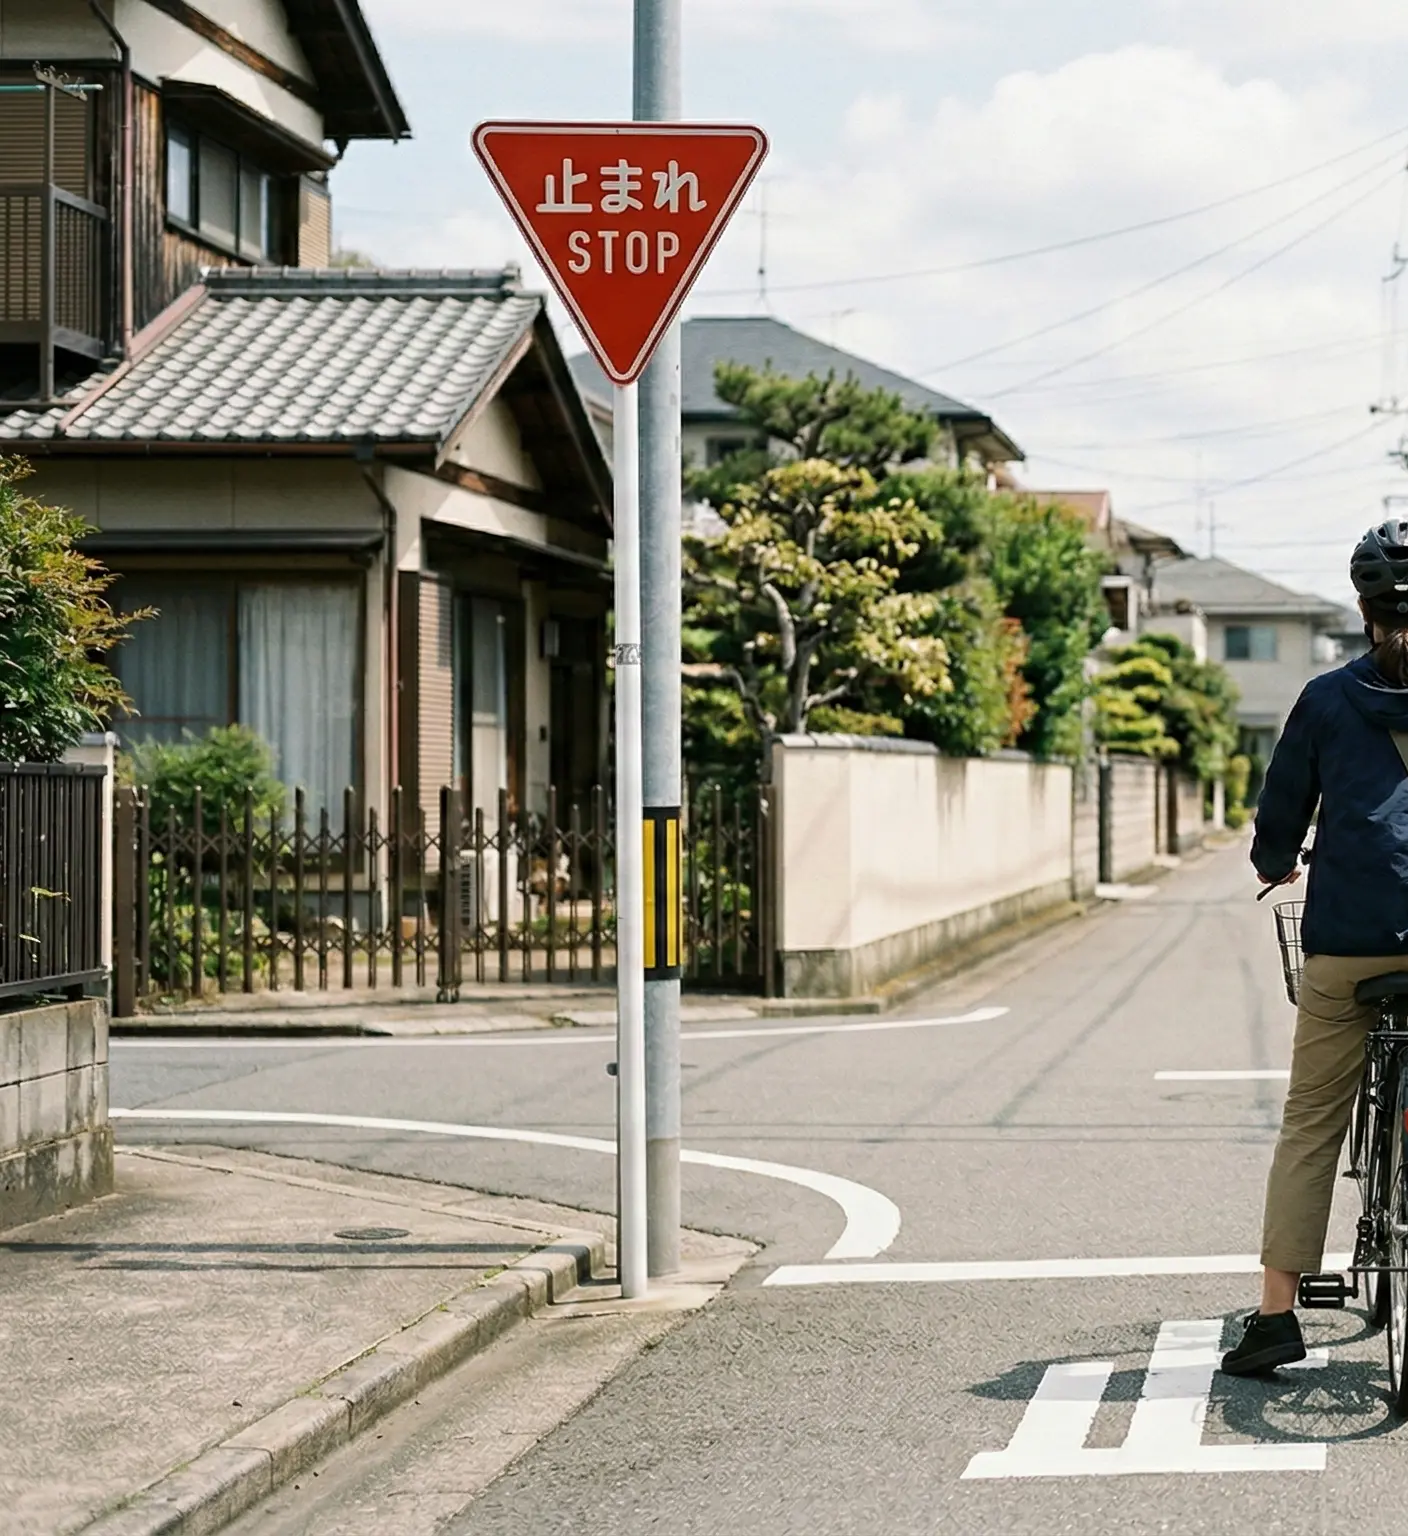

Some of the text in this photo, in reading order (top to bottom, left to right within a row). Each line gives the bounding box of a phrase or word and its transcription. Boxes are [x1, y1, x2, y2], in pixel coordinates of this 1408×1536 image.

[536, 158, 707, 213] 止まれ
[568, 231, 680, 273] STOP
[960, 1319, 1328, 1479] 止
